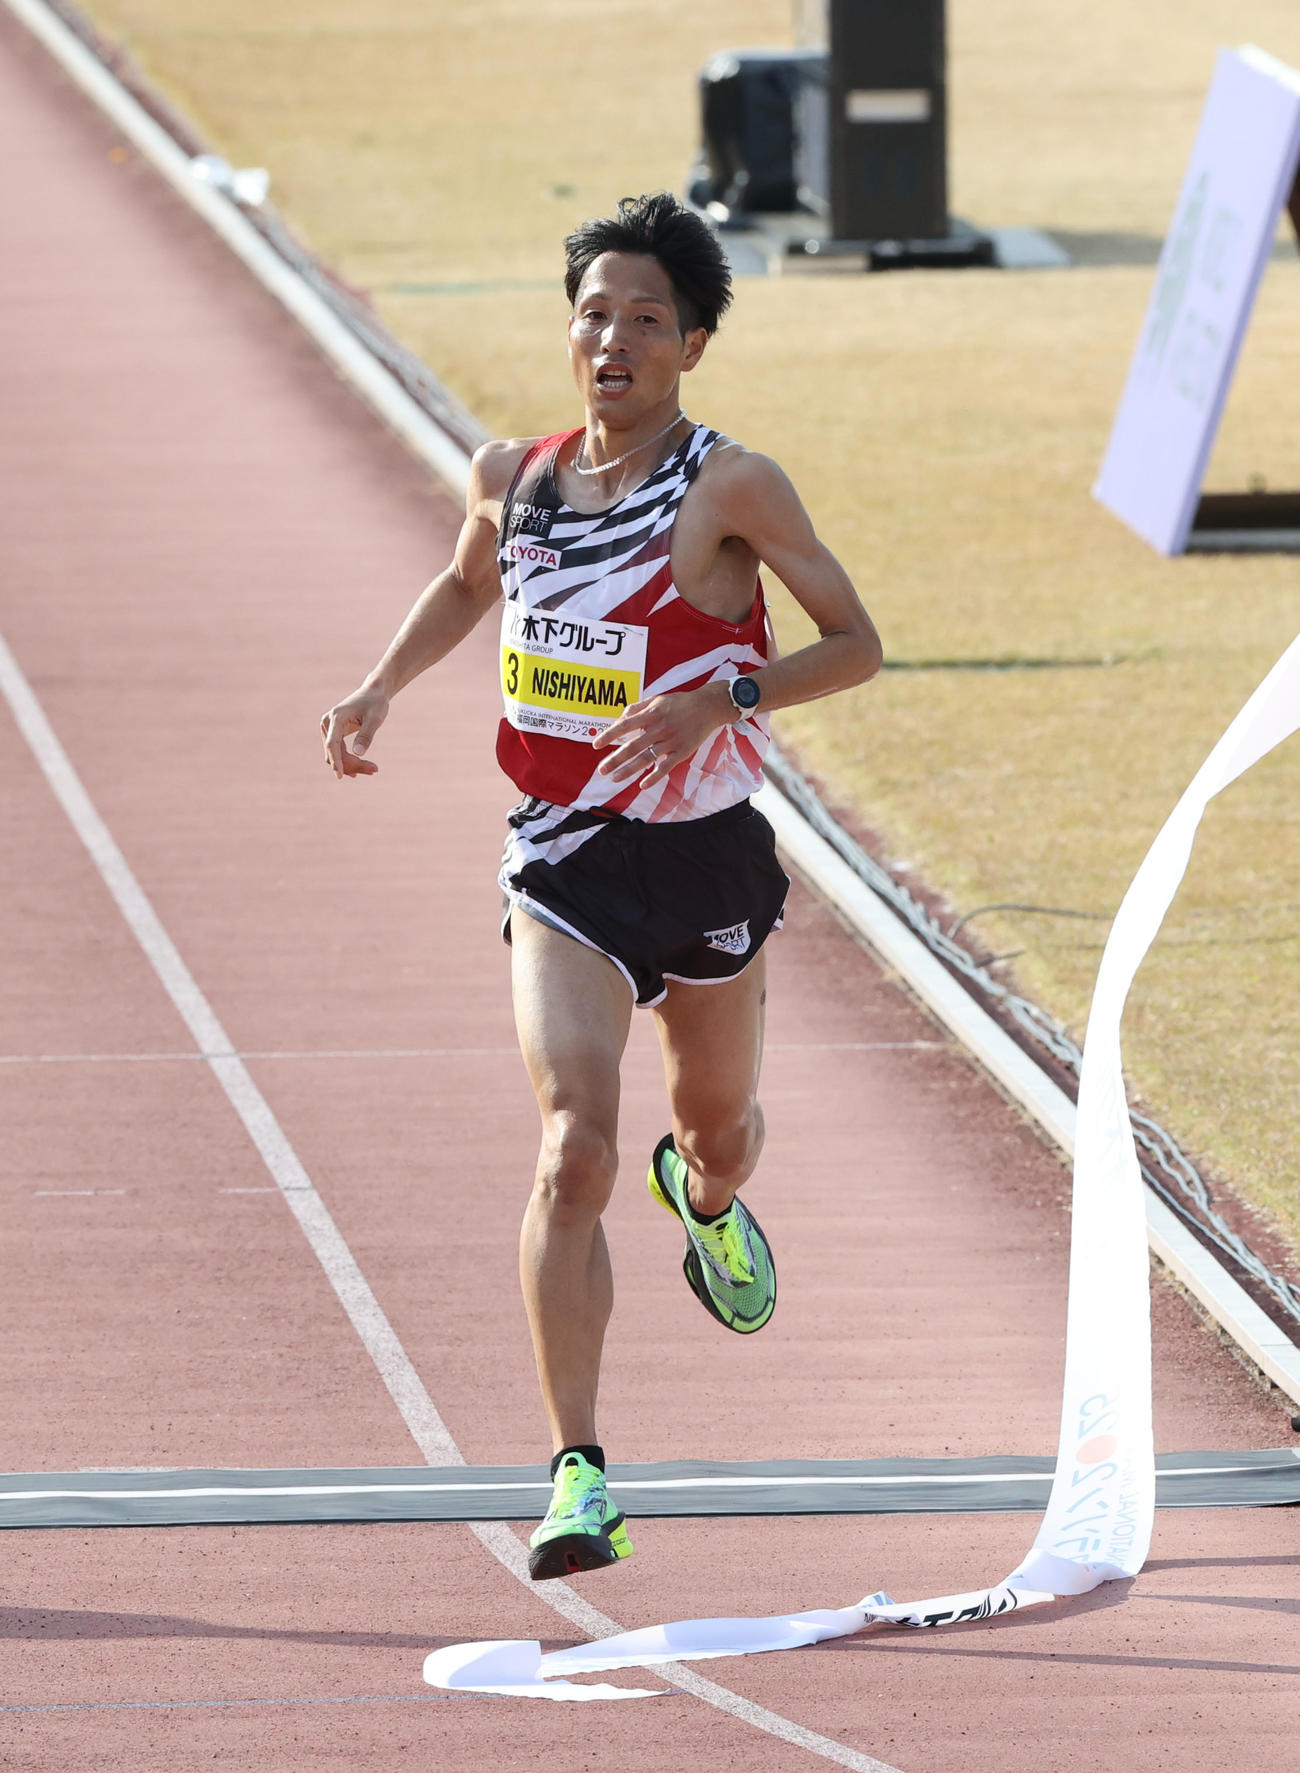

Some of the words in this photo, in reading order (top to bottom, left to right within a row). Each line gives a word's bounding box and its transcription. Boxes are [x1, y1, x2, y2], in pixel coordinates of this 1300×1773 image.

[513, 503, 551, 521] MOVE
[510, 515, 548, 532] SPORT
[522, 615, 626, 655] 木下グループ
[507, 653, 519, 695] 3
[532, 667, 628, 708] NISHIYAMA
[538, 713, 577, 724] INTERNATIONAL
